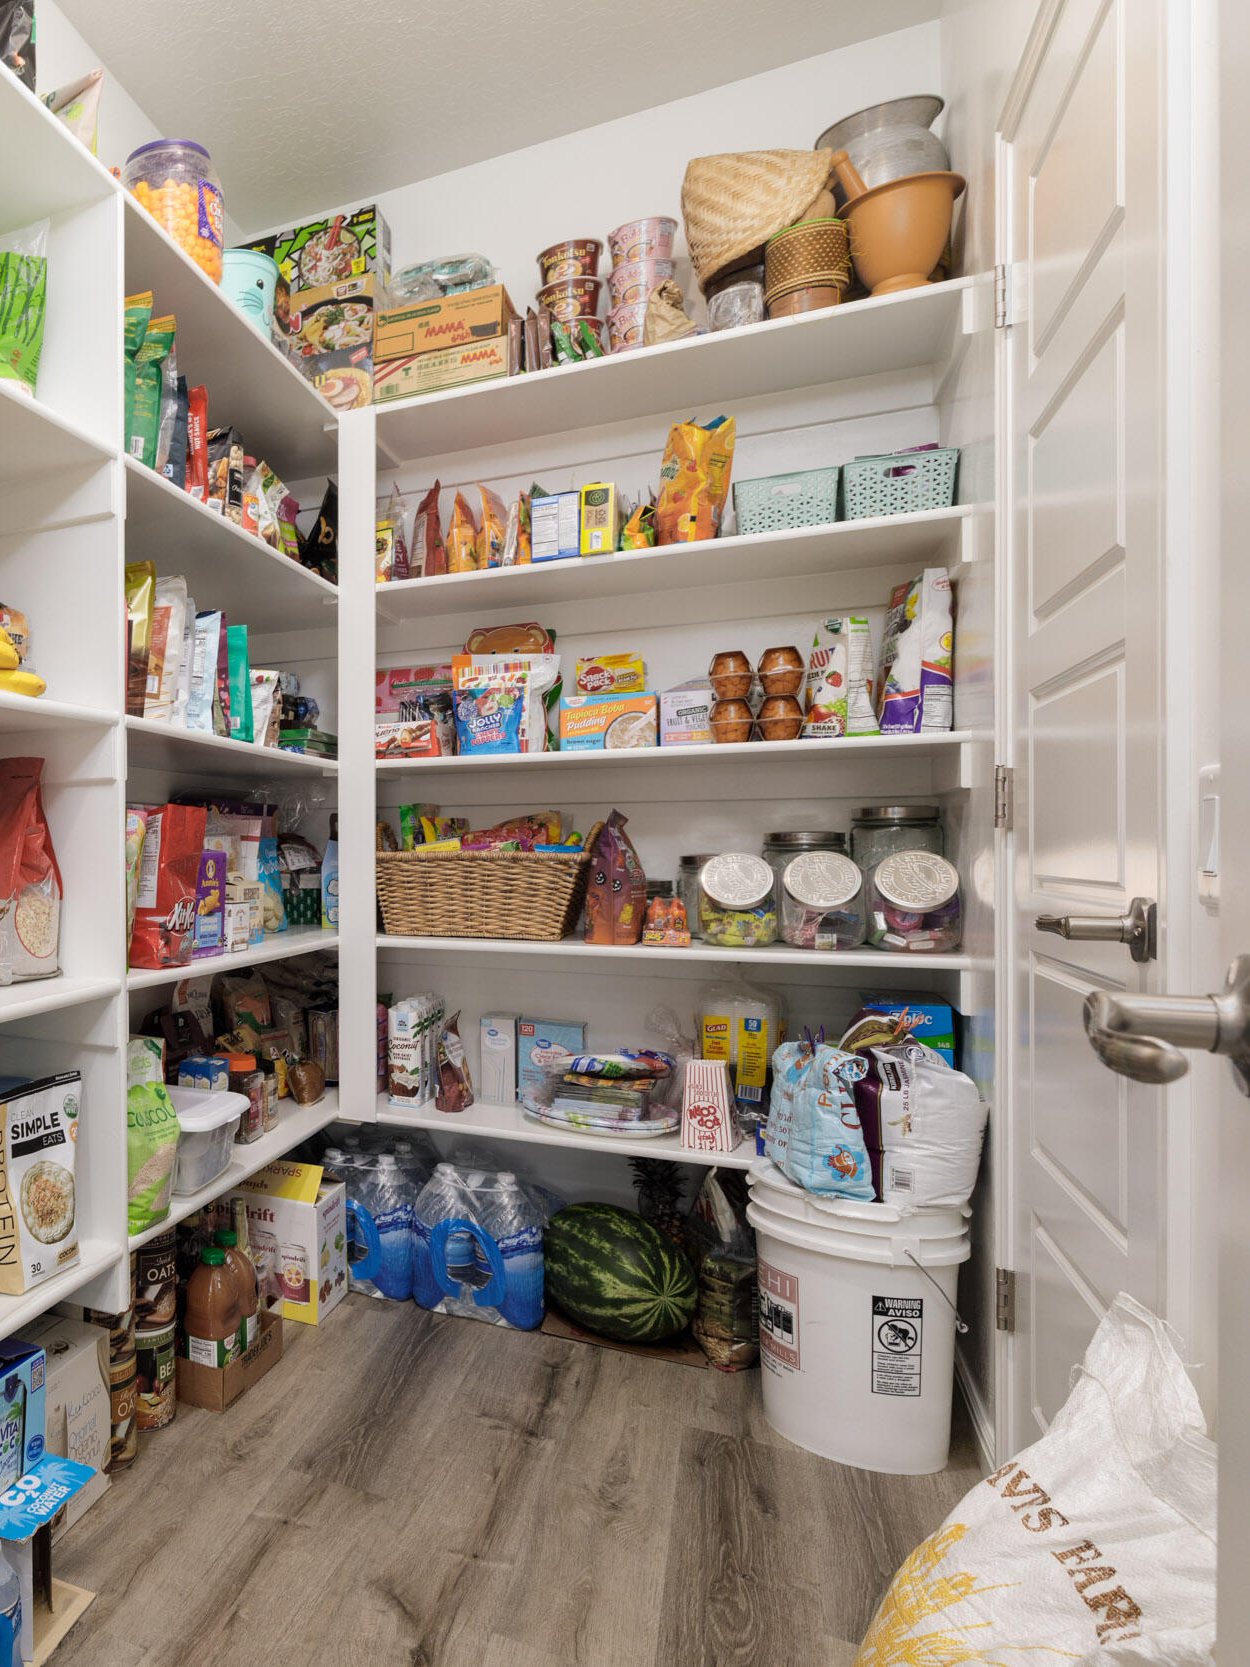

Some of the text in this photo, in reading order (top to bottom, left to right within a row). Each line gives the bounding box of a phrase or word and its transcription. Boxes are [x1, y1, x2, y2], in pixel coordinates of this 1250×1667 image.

[424, 320, 465, 339] MAMA
[460, 348, 497, 364] MAMA
[579, 670, 612, 685] Snack
[587, 678, 612, 691] pack
[565, 703, 626, 720] Tapioca Boba
[468, 712, 501, 730] JOLLY
[566, 715, 607, 731] Pudding
[811, 724, 837, 732] SHAKE
[471, 732, 507, 747] POPPERS
[521, 1024, 533, 1033] 120
[706, 1023, 728, 1033] GLAD
[388, 1039, 421, 1051] Coconut
[885, 1063, 899, 1092] KIRKLAND
[902, 1092, 910, 1101] LB
[688, 1105, 717, 1120] CORN
[902, 1101, 910, 1112] 25
[10, 1111, 61, 1141] SIMPLE
[698, 1116, 721, 1130] POP
[42, 1132, 64, 1147] EATS
[31, 1262, 42, 1274] 30
[146, 1261, 176, 1281] OATS
[884, 1298, 921, 1310] WARNING
[887, 1309, 920, 1318] AVISO
[0, 1420, 19, 1439] VITA
[26, 1480, 62, 1514] COCONUT
[33, 1485, 72, 1517] WATER
